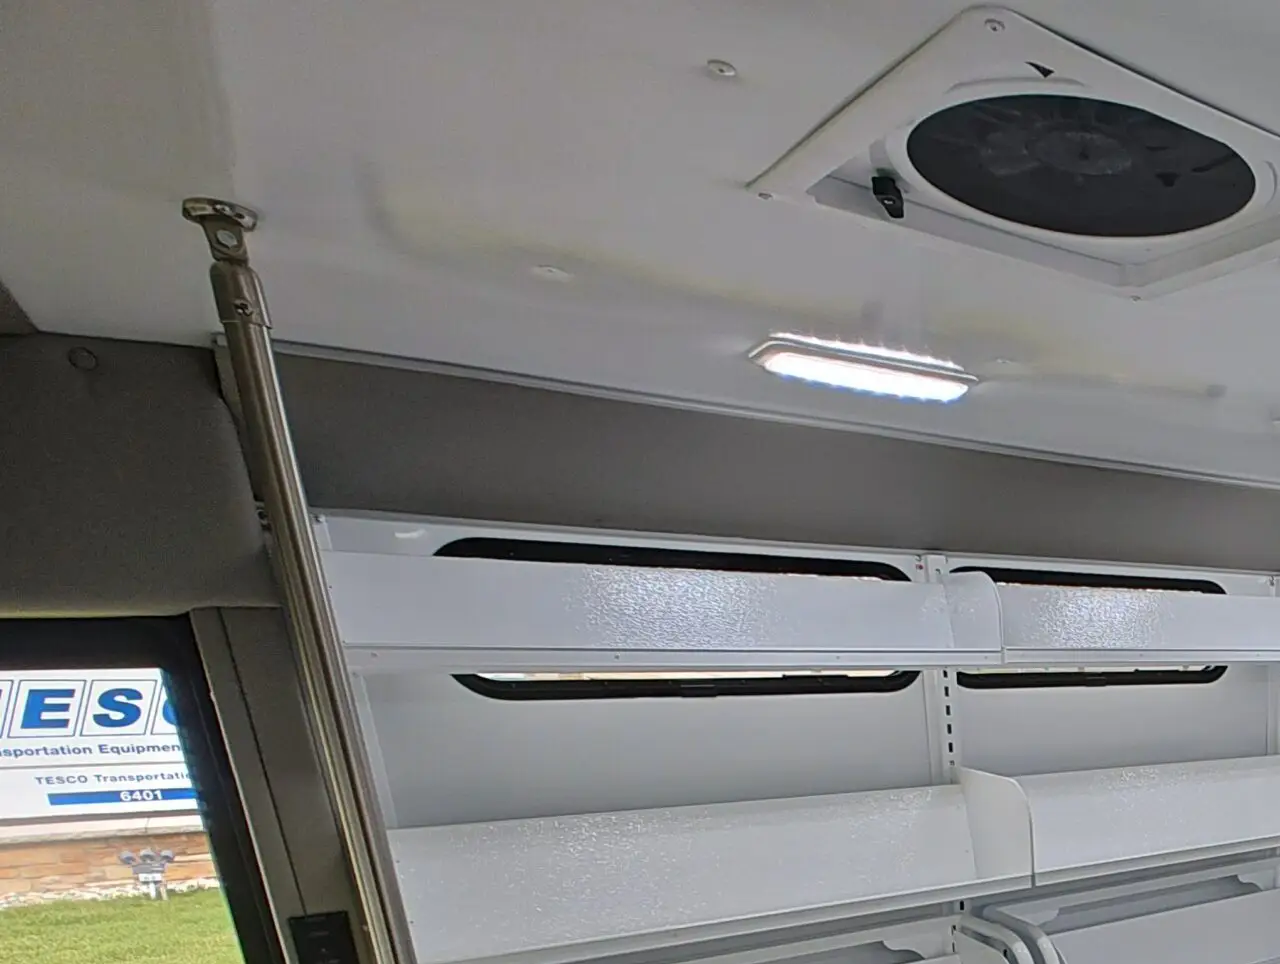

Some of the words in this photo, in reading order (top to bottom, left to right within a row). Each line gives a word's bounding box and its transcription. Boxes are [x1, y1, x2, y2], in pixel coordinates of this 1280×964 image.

[0, 688, 178, 730] ES
[0, 745, 93, 759] sportation
[34, 775, 89, 786] TESCO
[119, 790, 163, 802] 6401
